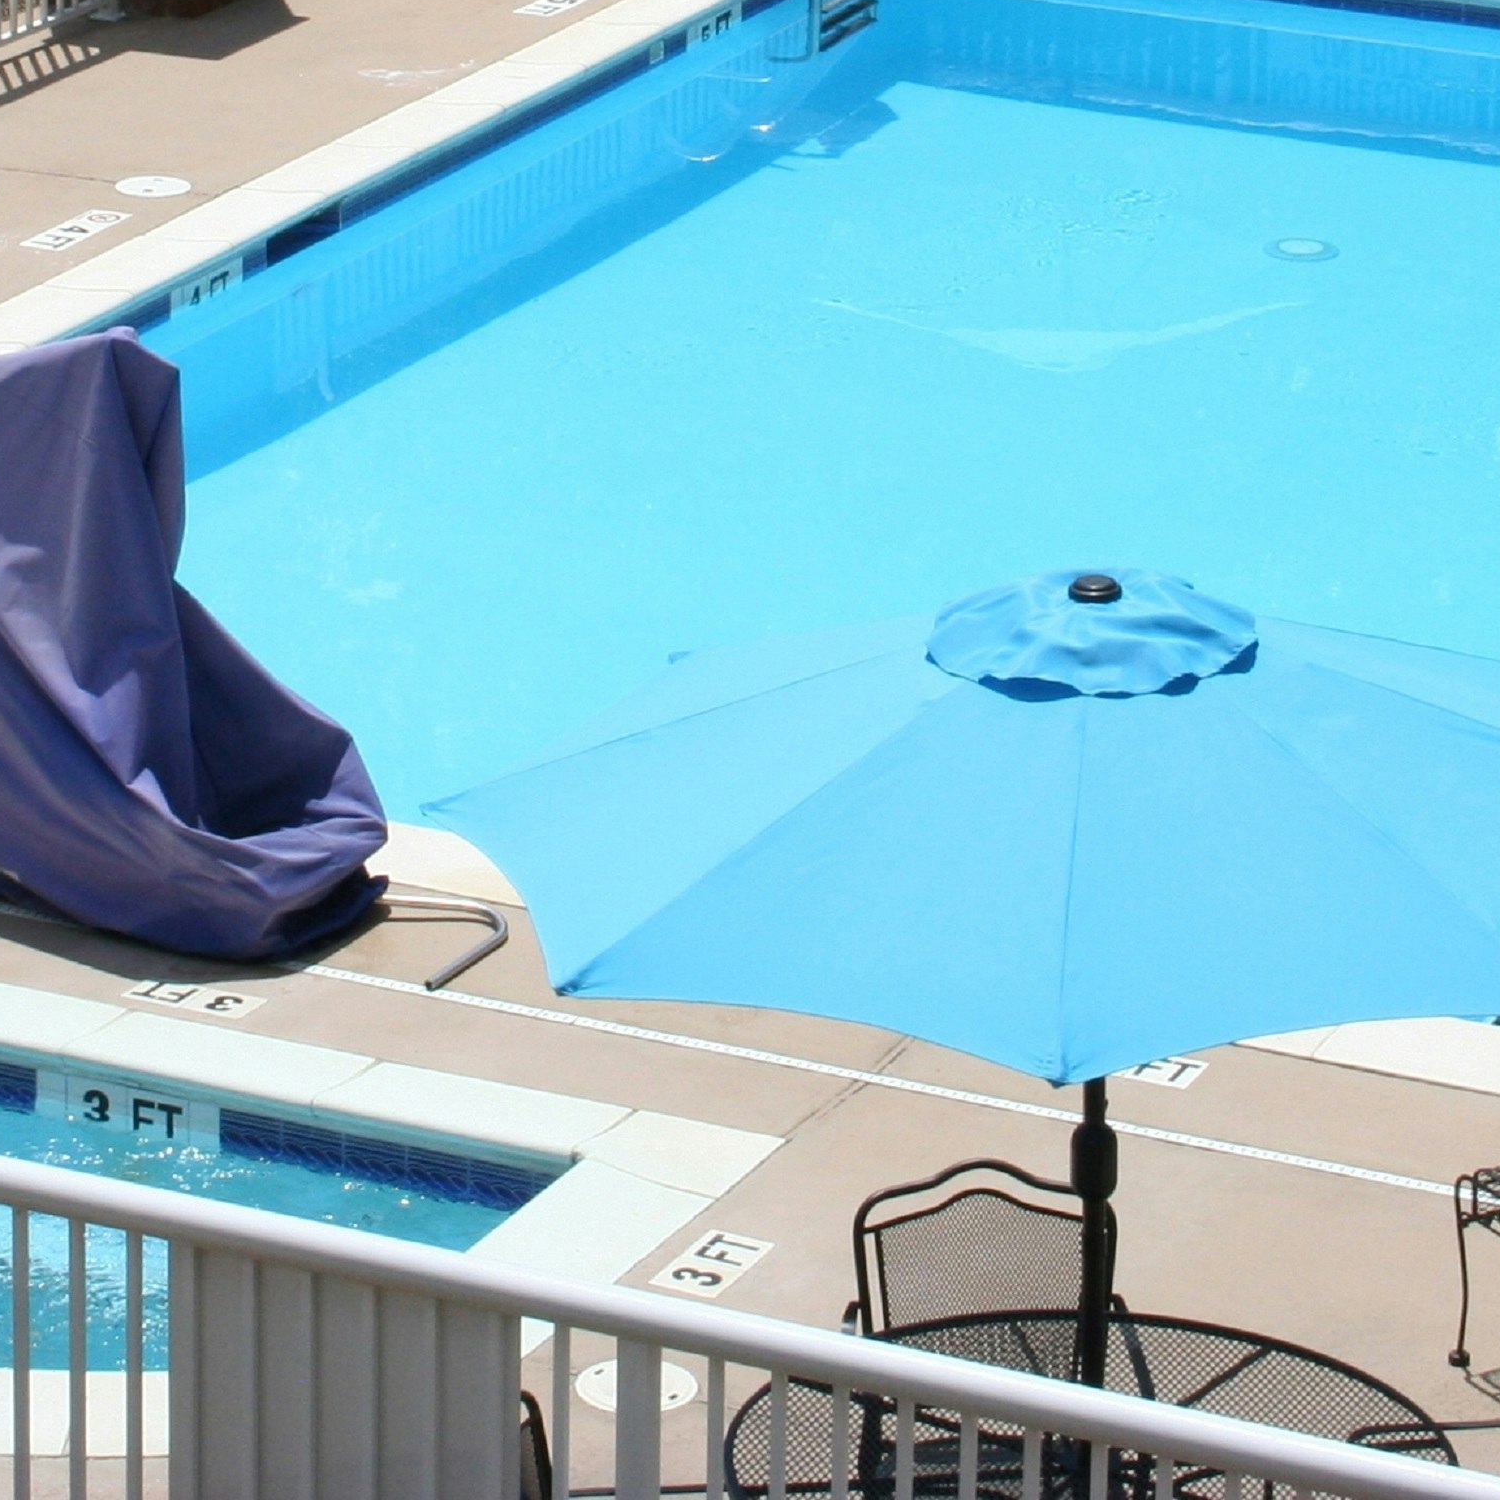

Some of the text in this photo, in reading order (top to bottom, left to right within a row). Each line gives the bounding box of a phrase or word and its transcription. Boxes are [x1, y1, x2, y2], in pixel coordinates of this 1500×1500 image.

[30, 234, 77, 248] FT
[129, 982, 244, 1011] 3 FT
[82, 1089, 183, 1138] 3 FT
[671, 1233, 760, 1287] 3 FT
